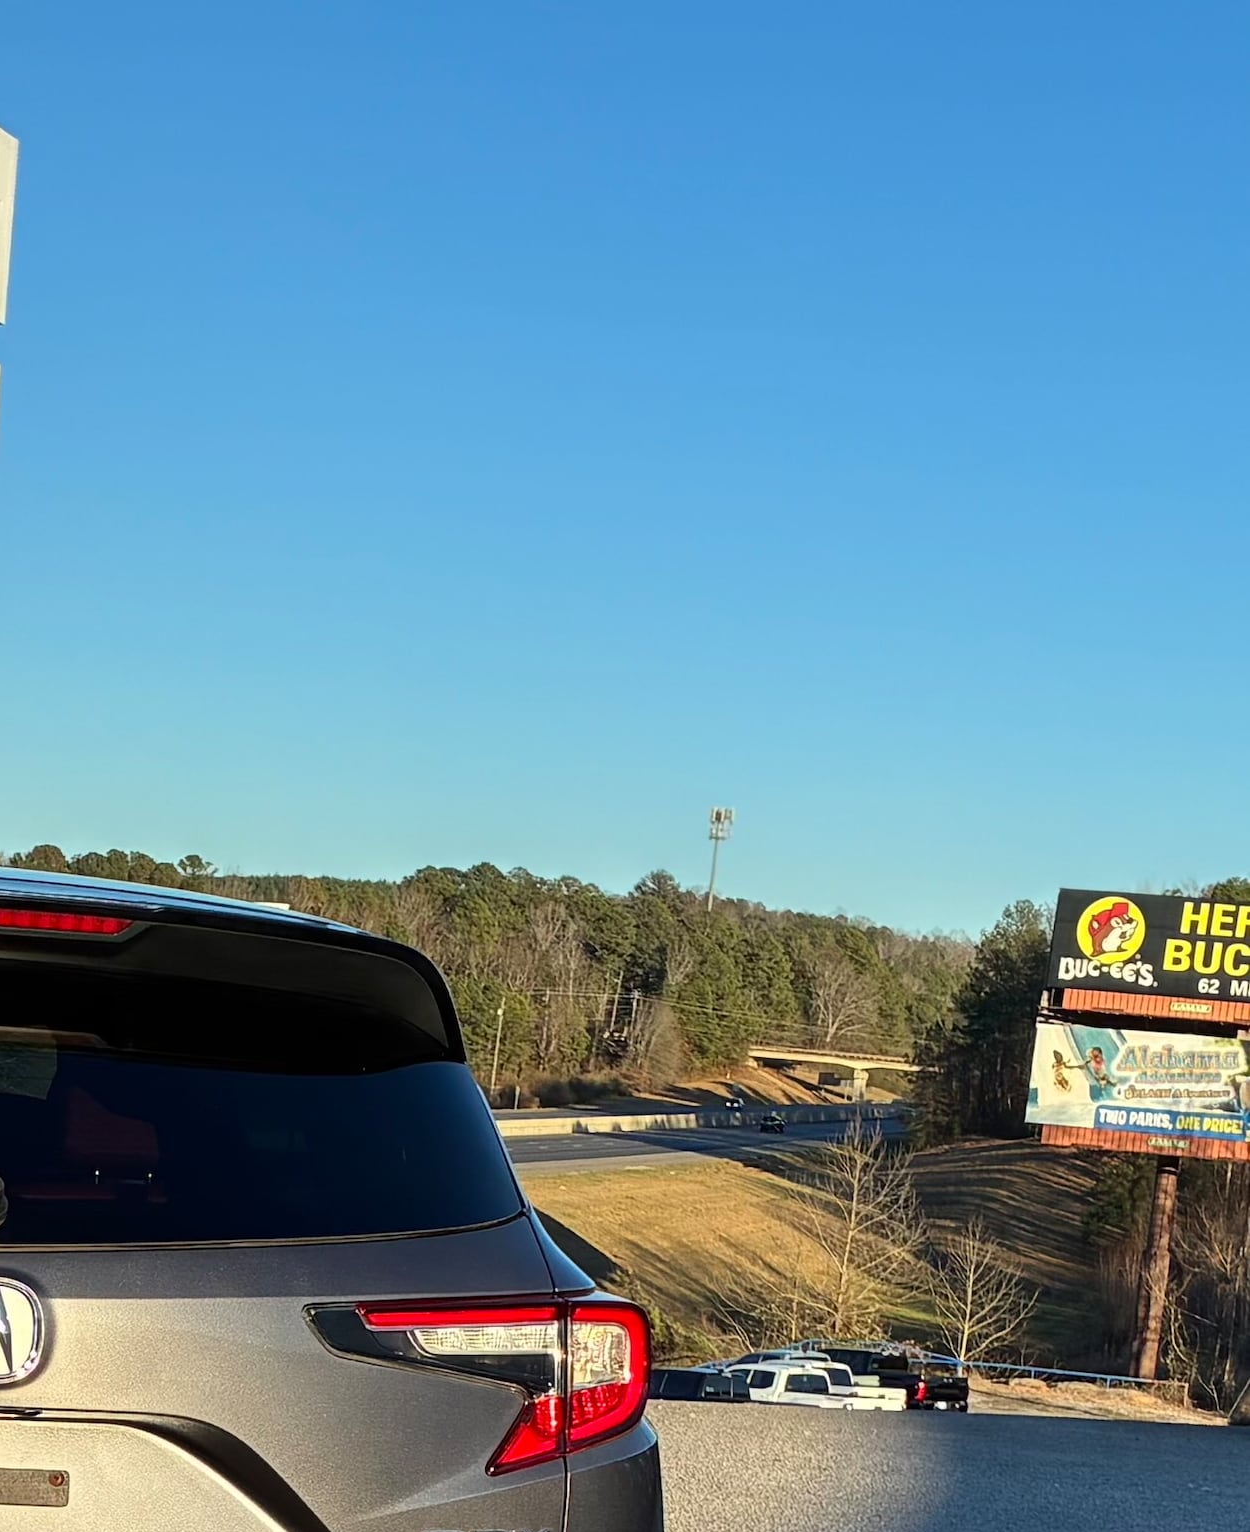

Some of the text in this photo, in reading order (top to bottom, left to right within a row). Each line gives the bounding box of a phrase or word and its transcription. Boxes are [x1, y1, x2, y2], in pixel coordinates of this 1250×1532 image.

[1197, 978, 1250, 997] 62 M
[1117, 1044, 1240, 1071] Alabama
[1098, 1108, 1243, 1134] TWO PARKS, ONE PRICE!
